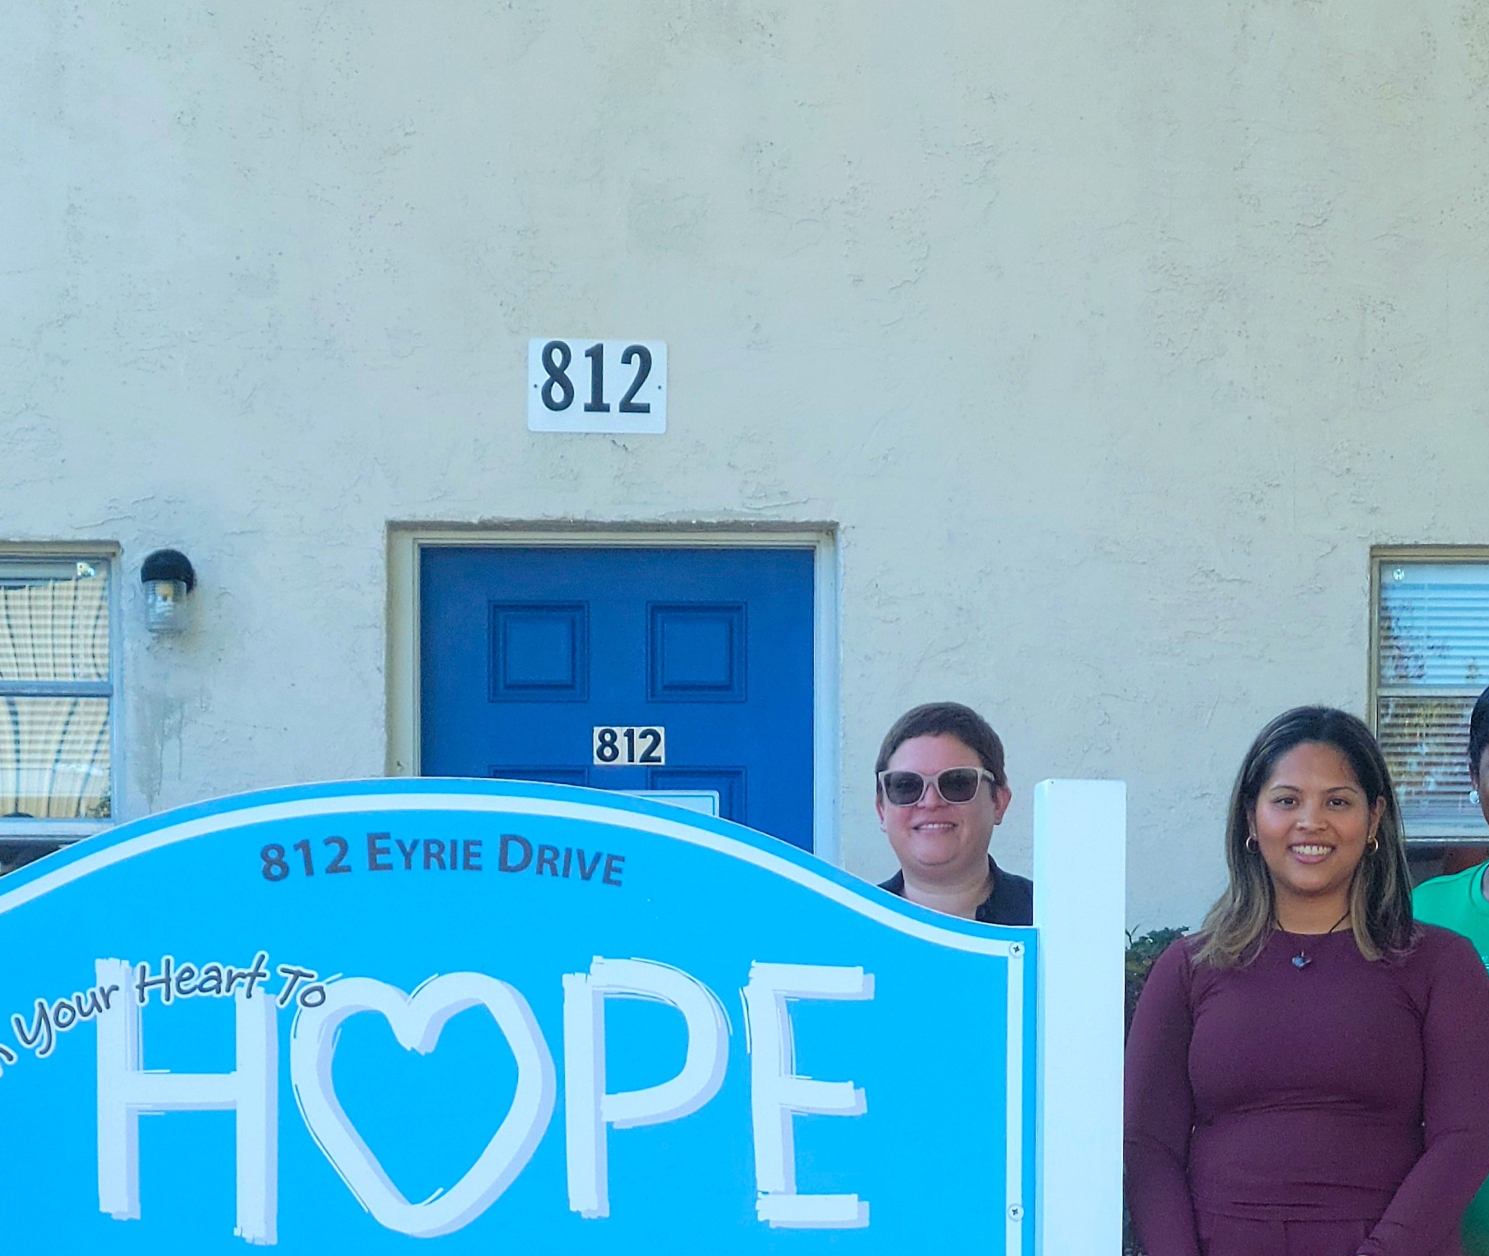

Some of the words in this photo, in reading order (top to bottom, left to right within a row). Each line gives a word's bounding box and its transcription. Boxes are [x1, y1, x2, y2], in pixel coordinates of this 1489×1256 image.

[541, 340, 652, 413] 812
[596, 728, 662, 763] 812
[260, 835, 352, 882] 812
[366, 831, 483, 873] EYRIE
[497, 833, 626, 887] DRIVE
[14, 982, 120, 1057] Your
[135, 952, 268, 1005] Heart
[278, 966, 327, 1008] To
